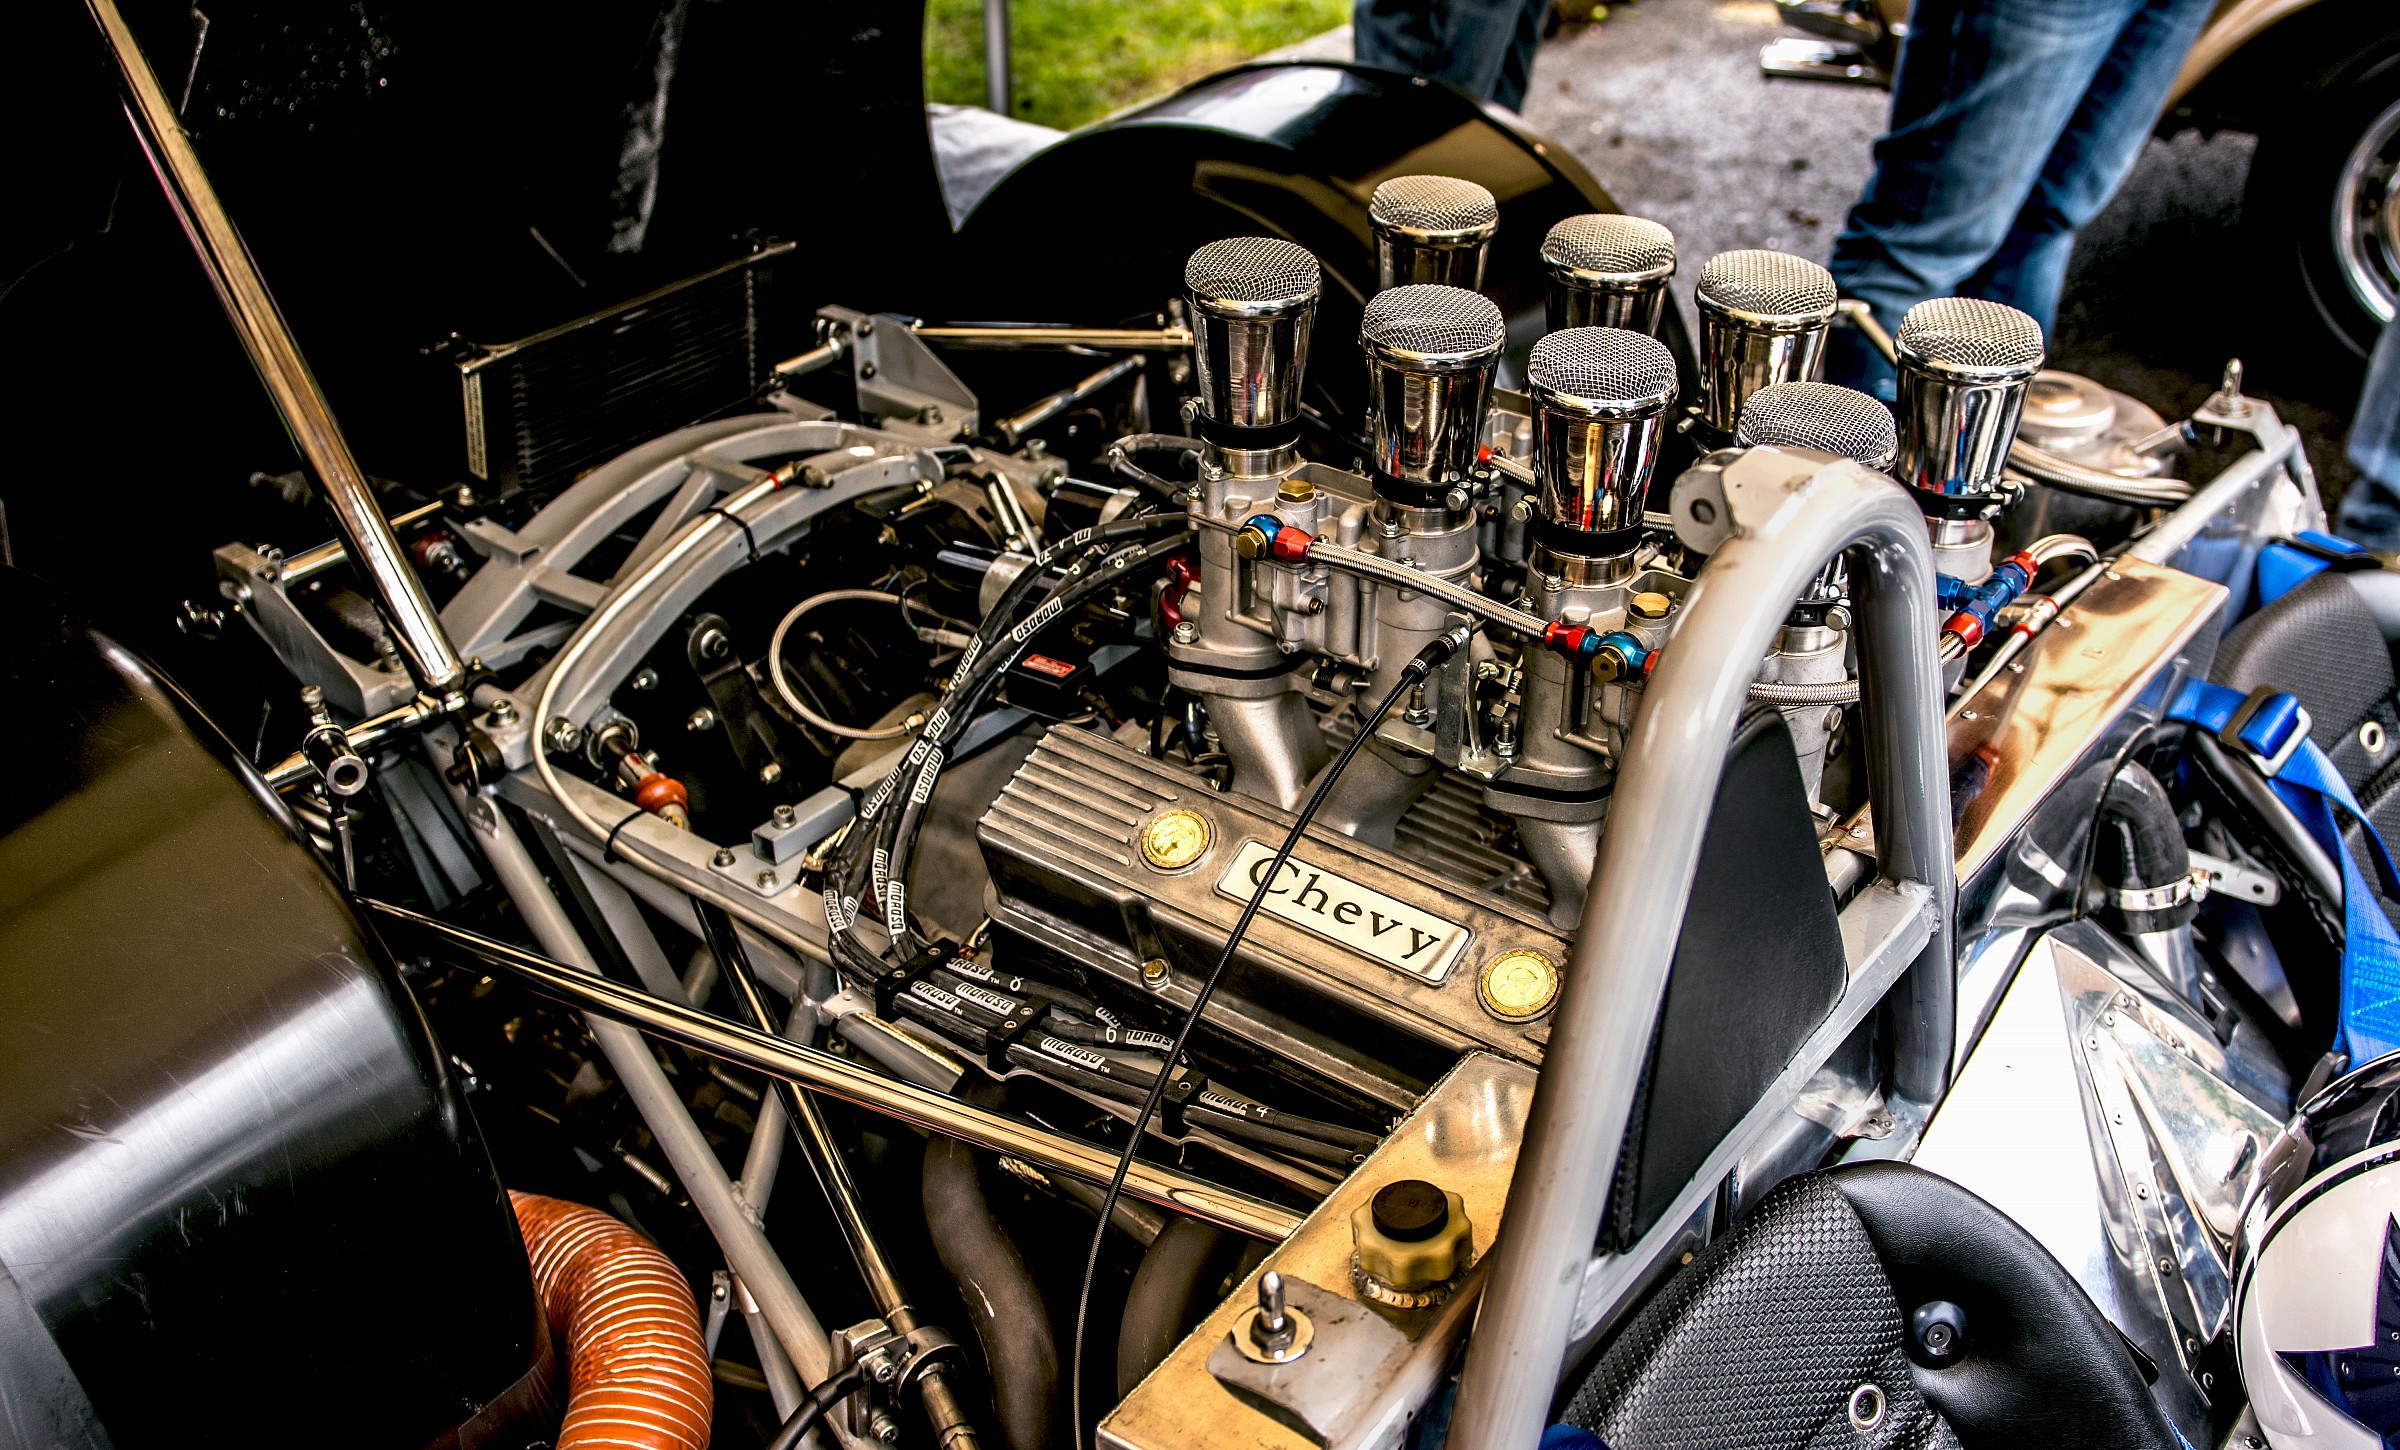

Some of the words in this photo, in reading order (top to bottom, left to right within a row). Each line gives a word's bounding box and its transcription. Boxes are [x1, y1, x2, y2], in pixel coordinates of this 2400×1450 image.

[1014, 598, 1062, 641] MOROSO
[913, 747, 944, 802] MOROSO
[824, 890, 847, 930] MOROSO
[889, 882, 905, 931] MOROSO
[1248, 857, 1441, 960] Chevy
[957, 983, 1014, 1013] MOROSO
[1042, 1037, 1104, 1067] MOROSO
[1106, 1026, 1117, 1043] 6
